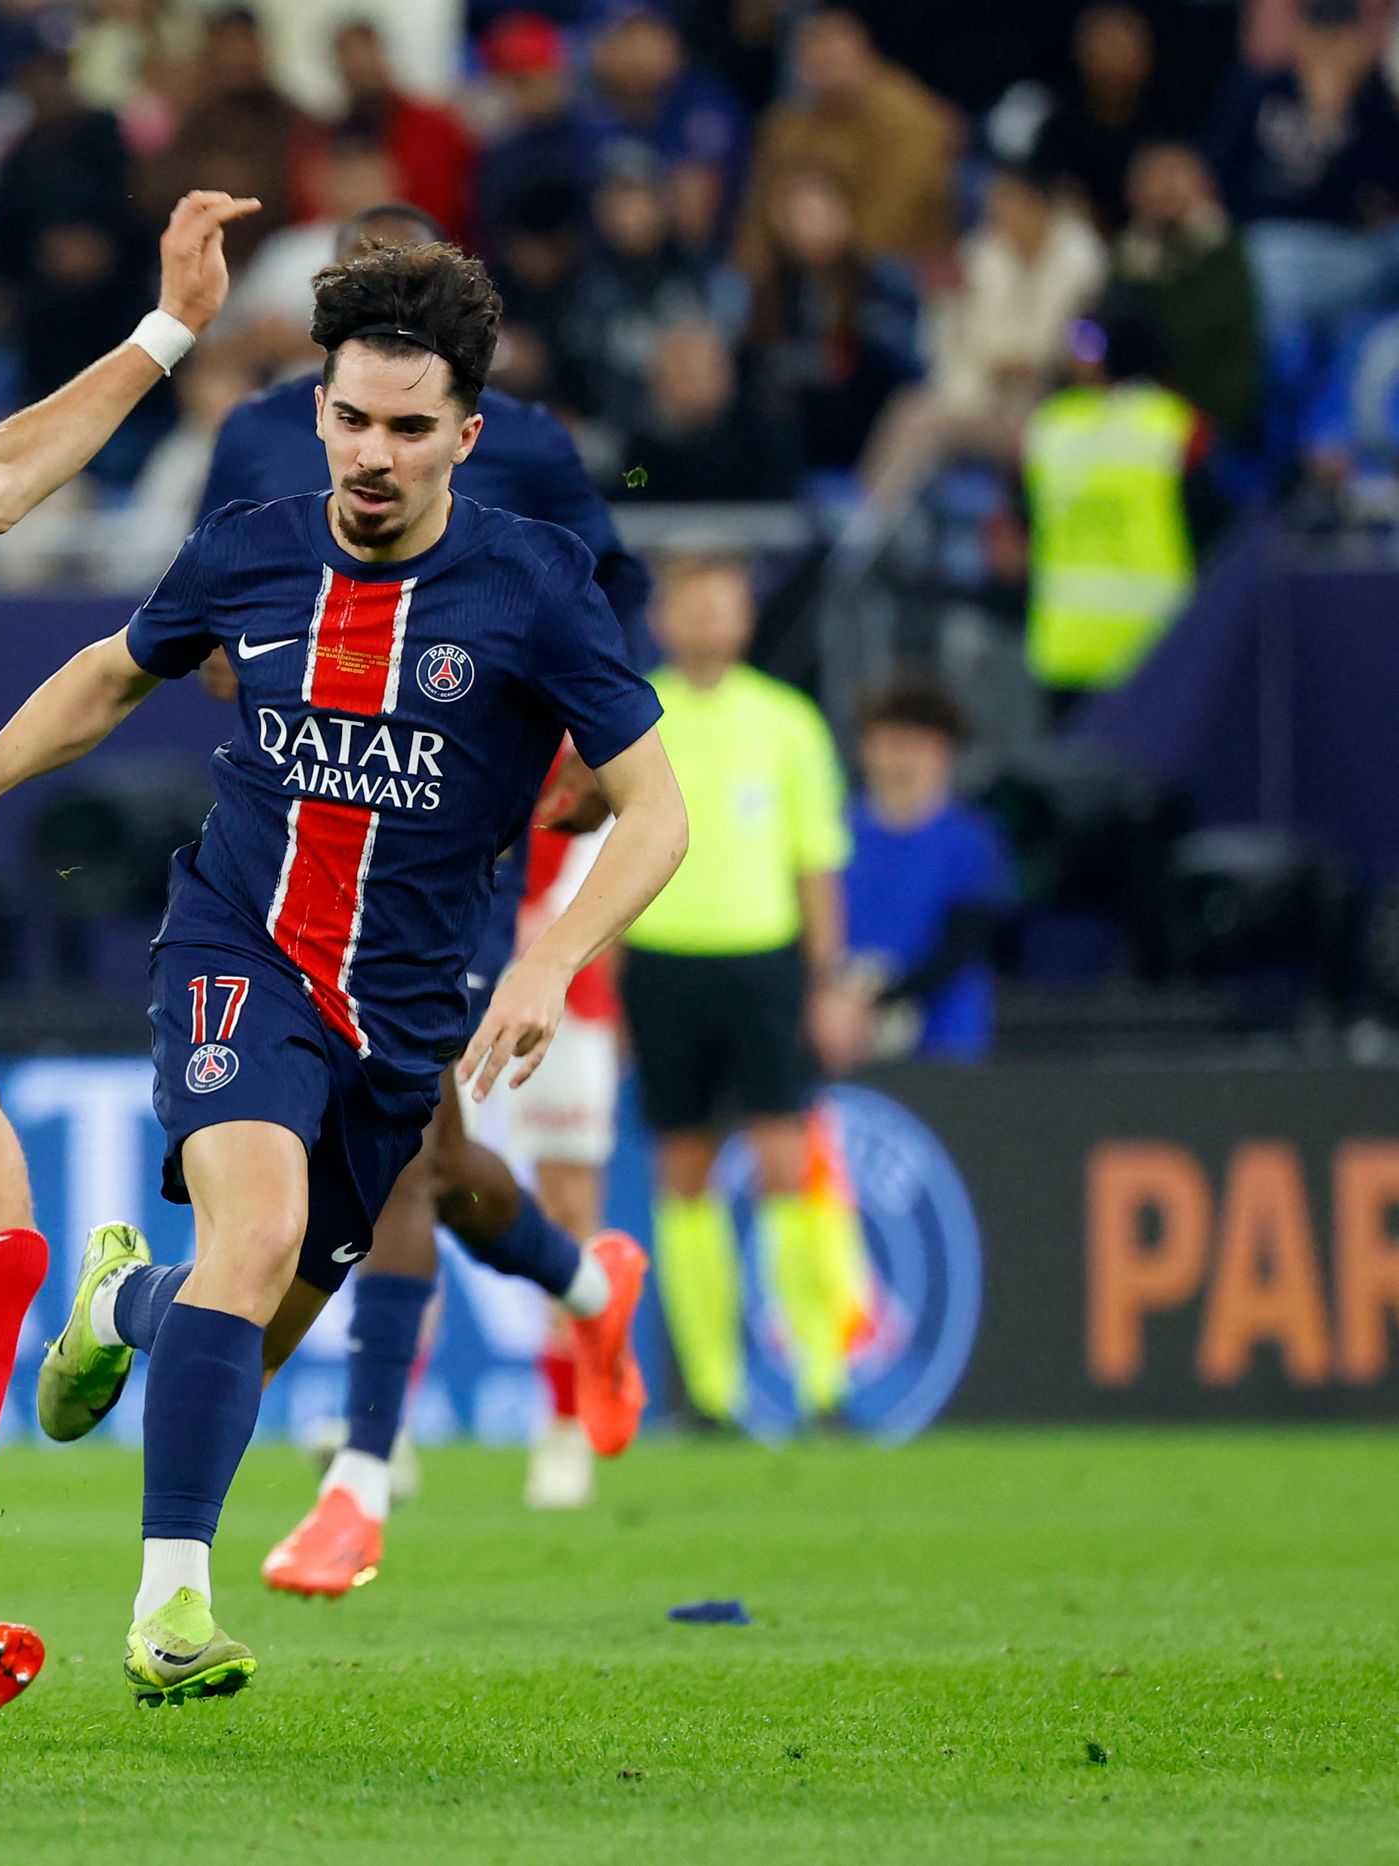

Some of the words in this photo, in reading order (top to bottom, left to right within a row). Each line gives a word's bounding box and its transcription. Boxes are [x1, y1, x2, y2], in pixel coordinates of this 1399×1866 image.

[429, 647, 467, 664] PARIS
[258, 707, 444, 777] QATAR
[282, 760, 442, 810] AIRWAYS
[188, 975, 250, 1044] 17
[192, 1046, 230, 1062] PARIS
